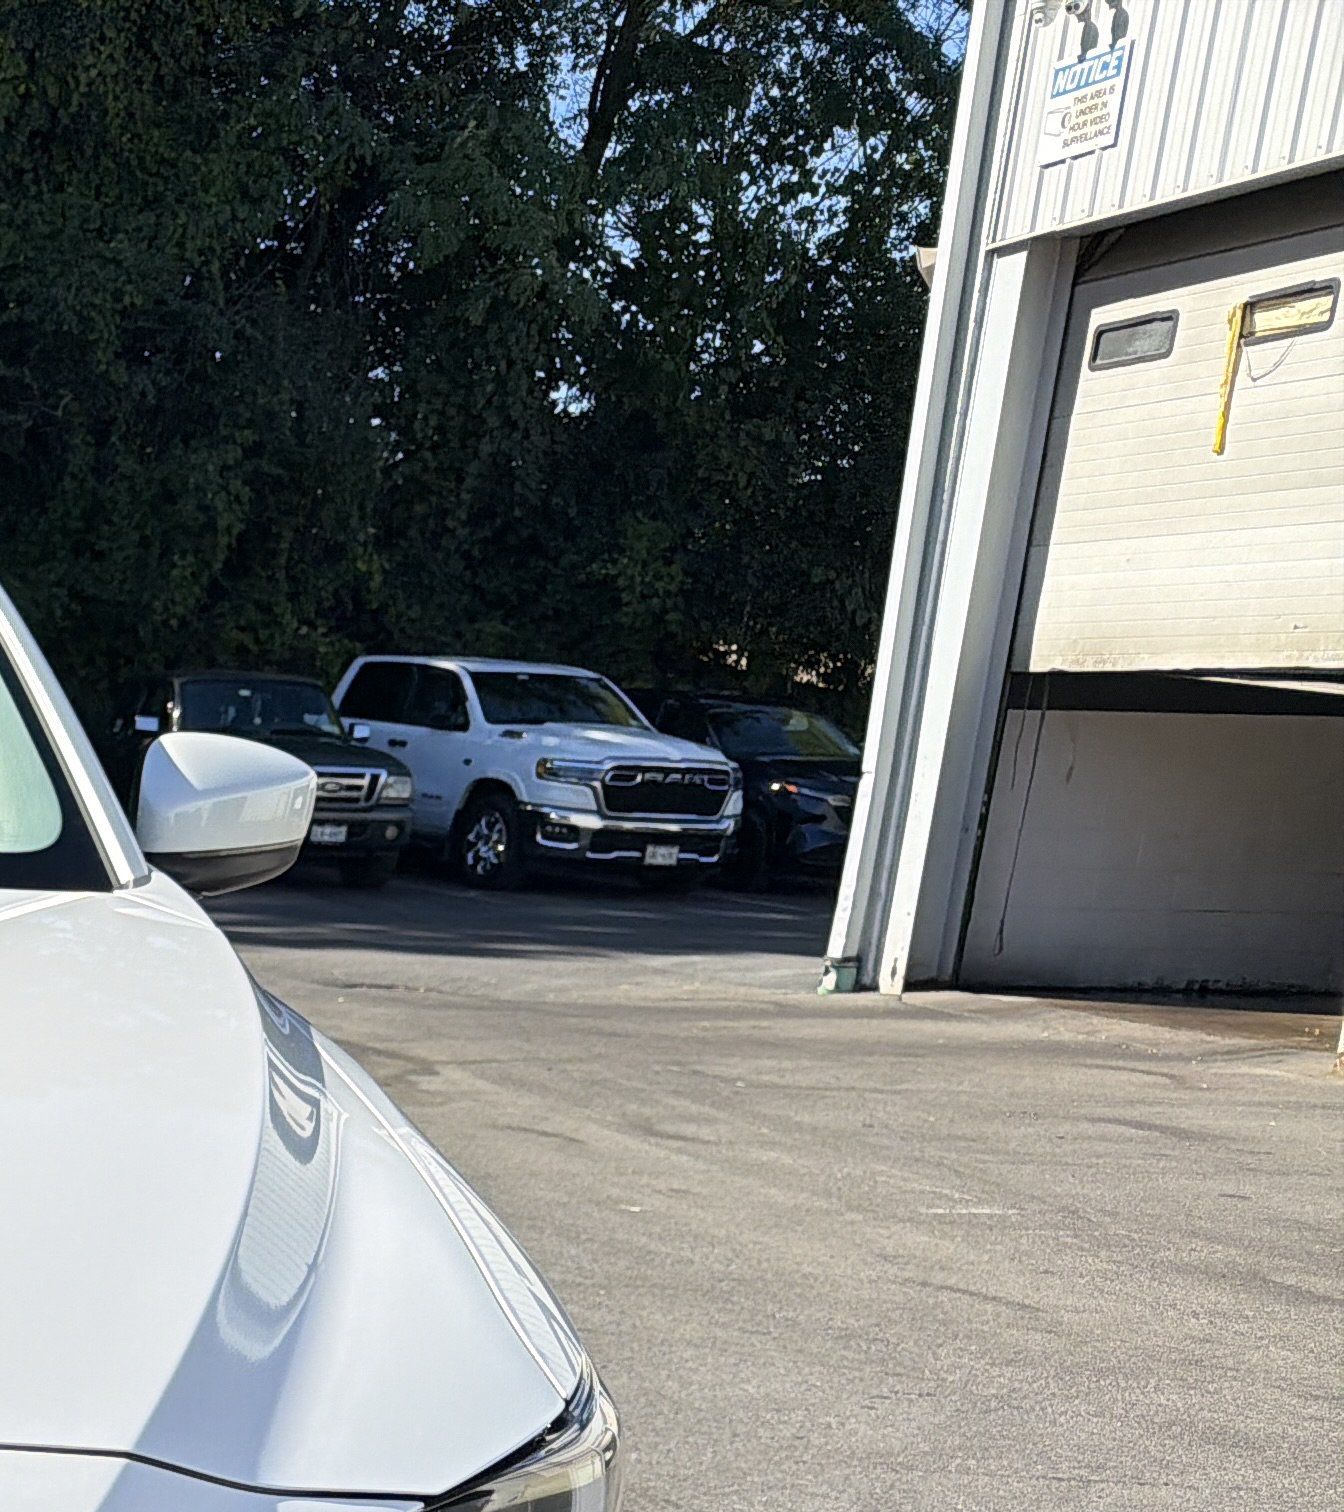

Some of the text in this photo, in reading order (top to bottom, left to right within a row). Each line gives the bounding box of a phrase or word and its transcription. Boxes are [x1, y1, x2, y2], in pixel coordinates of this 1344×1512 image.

[1052, 50, 1124, 95] NOTICE
[1073, 84, 1116, 106] THIS AREA IS
[1075, 103, 1099, 119] UNDER
[1069, 112, 1111, 134] HOUR VIDEO
[1062, 125, 1112, 149] SURVEILLANCE
